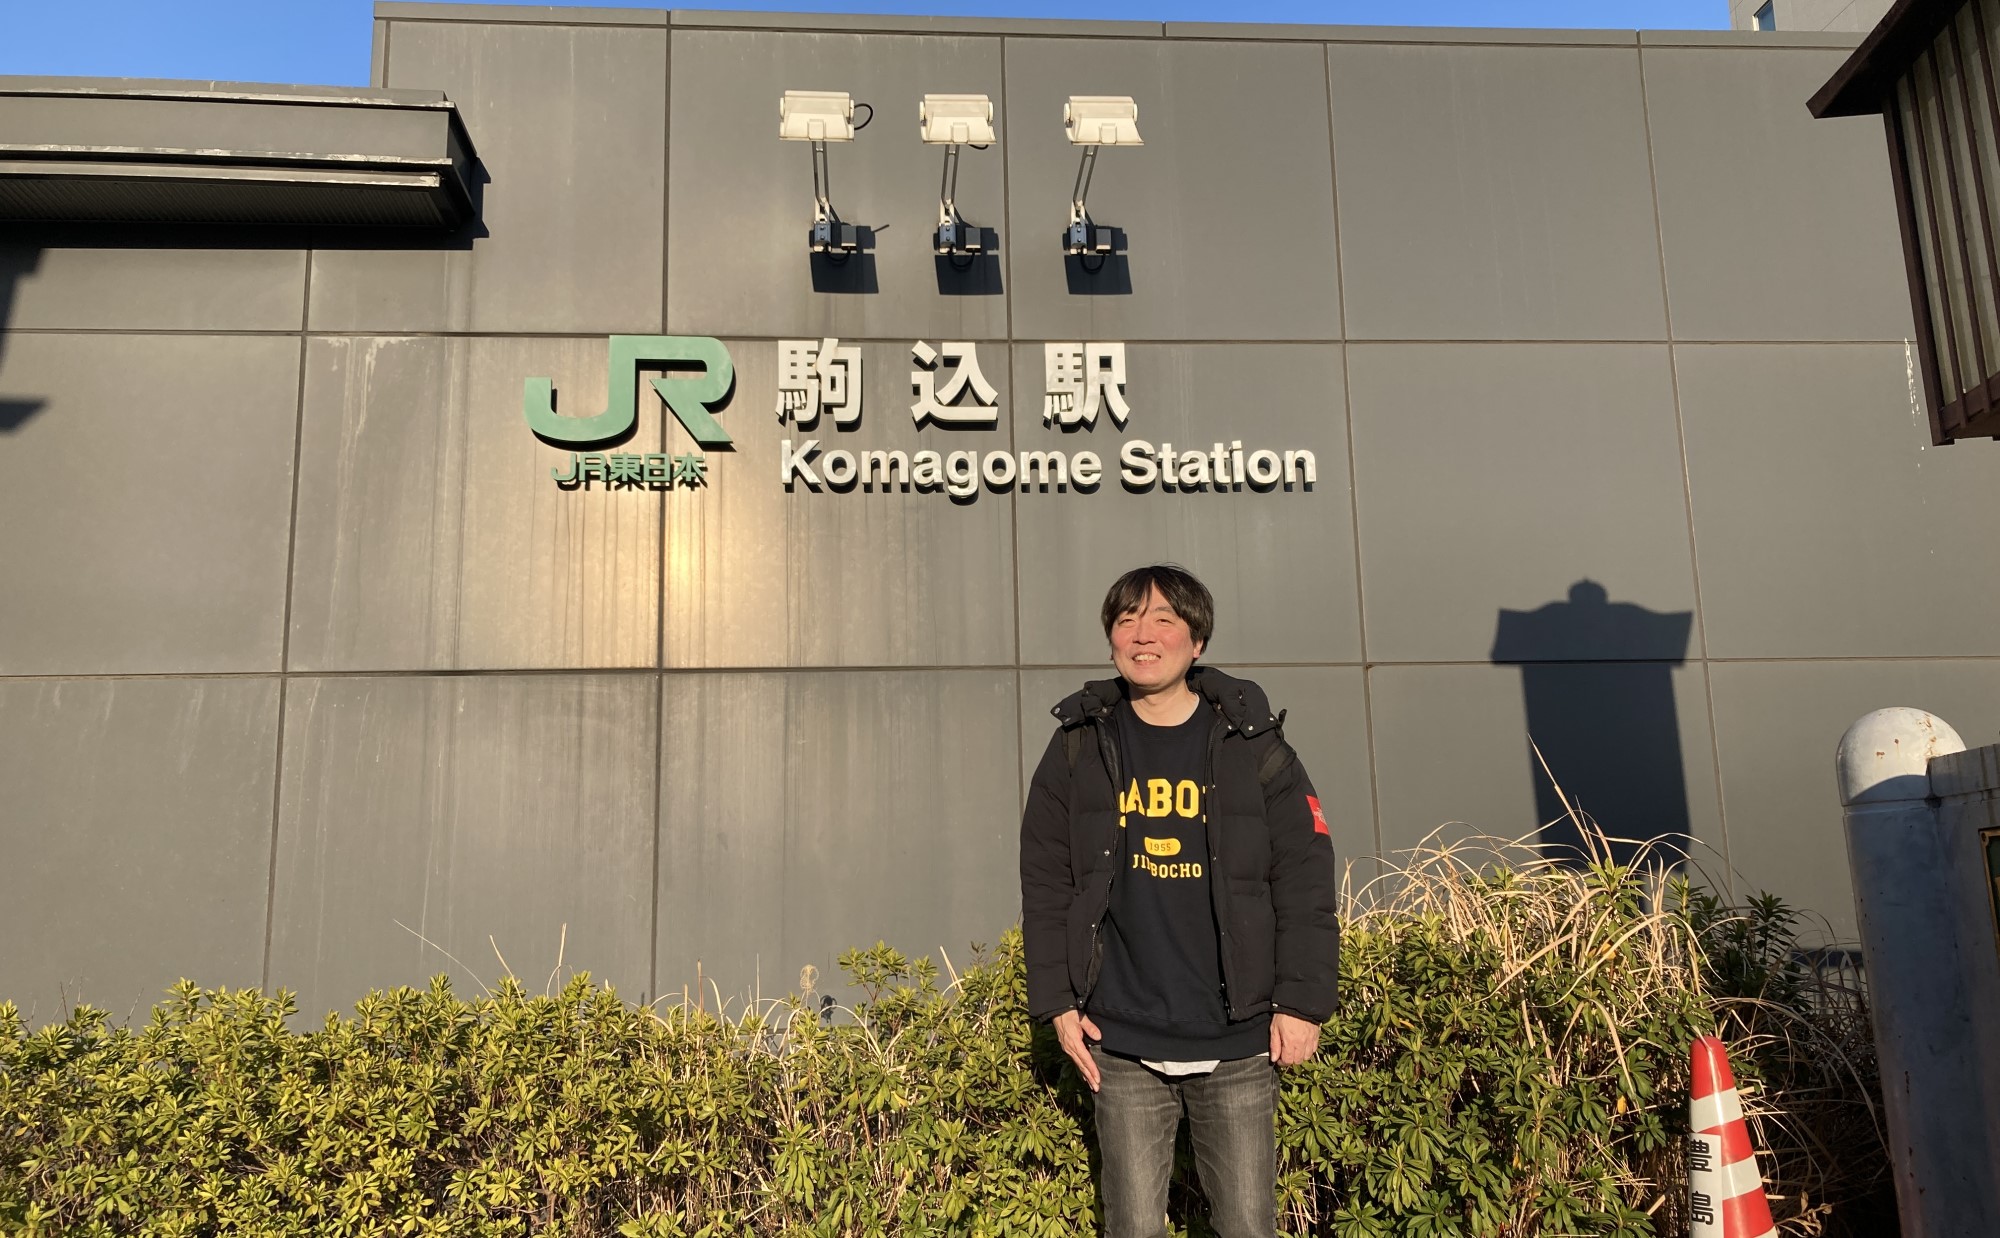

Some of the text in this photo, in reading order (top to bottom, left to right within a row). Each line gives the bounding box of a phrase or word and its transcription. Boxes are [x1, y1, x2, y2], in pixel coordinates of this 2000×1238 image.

[523, 335, 734, 442] JR
[775, 338, 1131, 424] 駒込駅
[552, 452, 705, 482] JR東日本
[781, 439, 1317, 498] Komagome Station
[1149, 842, 1172, 852] 1955
